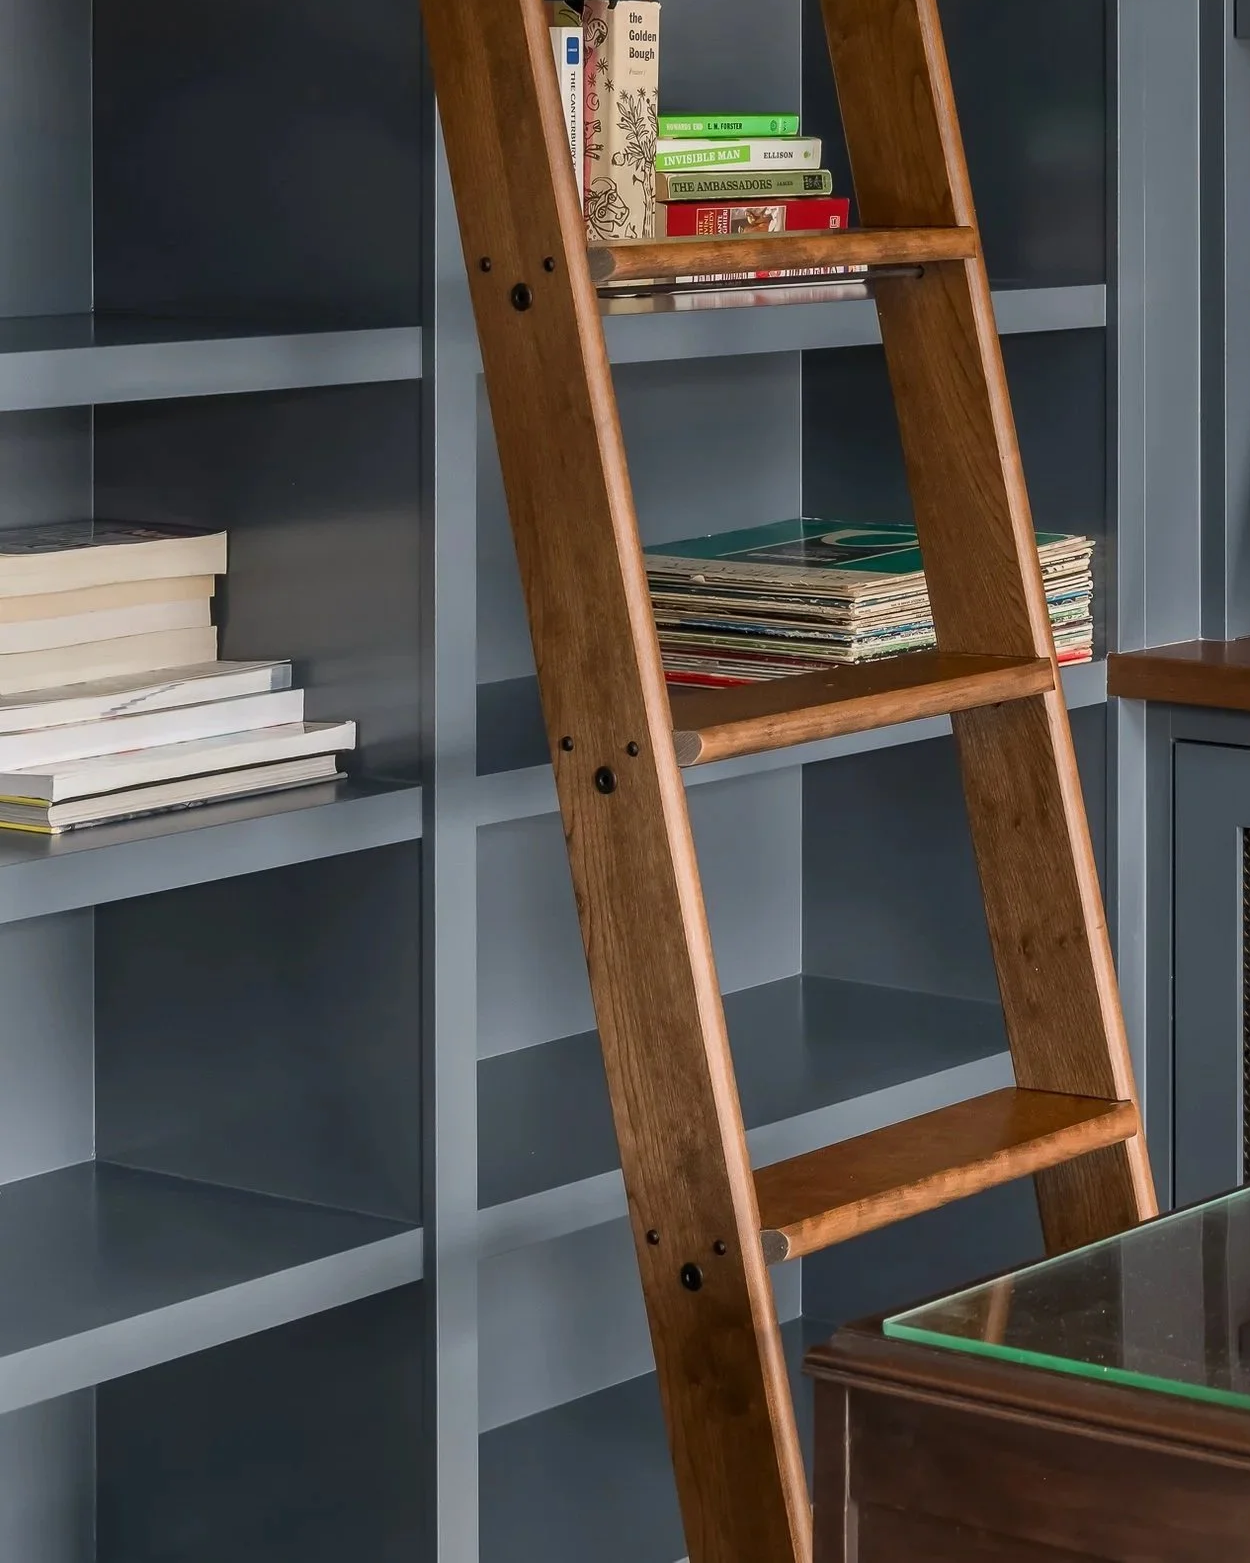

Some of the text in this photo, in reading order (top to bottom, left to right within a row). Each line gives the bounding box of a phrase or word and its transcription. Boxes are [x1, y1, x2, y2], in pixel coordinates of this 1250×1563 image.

[629, 12, 643, 24] the
[629, 29, 657, 42] Golden
[629, 47, 655, 62] Bough
[720, 122, 743, 130] FORSTER
[664, 149, 740, 166] INVISIBLE MAN
[763, 151, 794, 159] ELLISON
[672, 182, 695, 193] THE
[697, 179, 773, 192] AMBASSADORS
